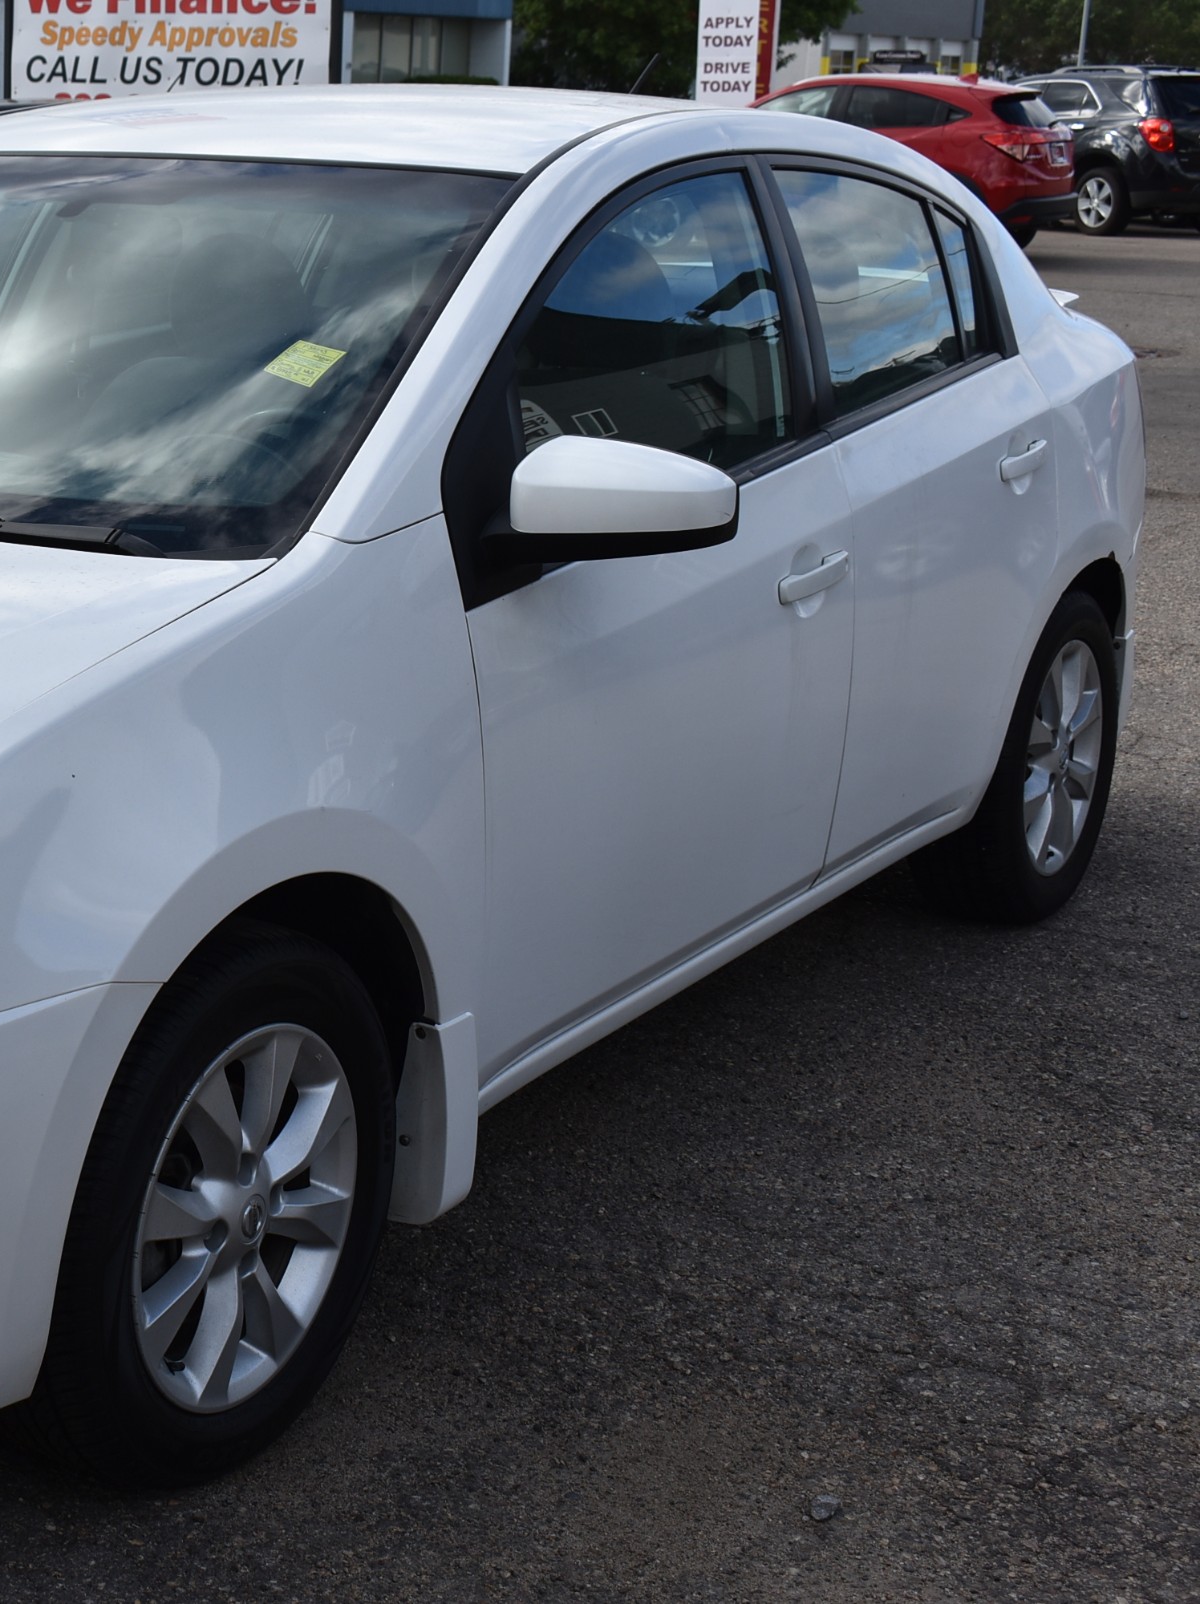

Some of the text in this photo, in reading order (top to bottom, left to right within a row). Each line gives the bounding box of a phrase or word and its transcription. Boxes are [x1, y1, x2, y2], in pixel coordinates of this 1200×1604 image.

[704, 16, 754, 29] APPLY
[39, 20, 298, 52] Speedy Approvals
[702, 35, 754, 47] TODAY
[26, 55, 305, 87] CALL US TODAY!
[703, 62, 751, 74] DRIVE
[700, 80, 751, 93] TODAY
